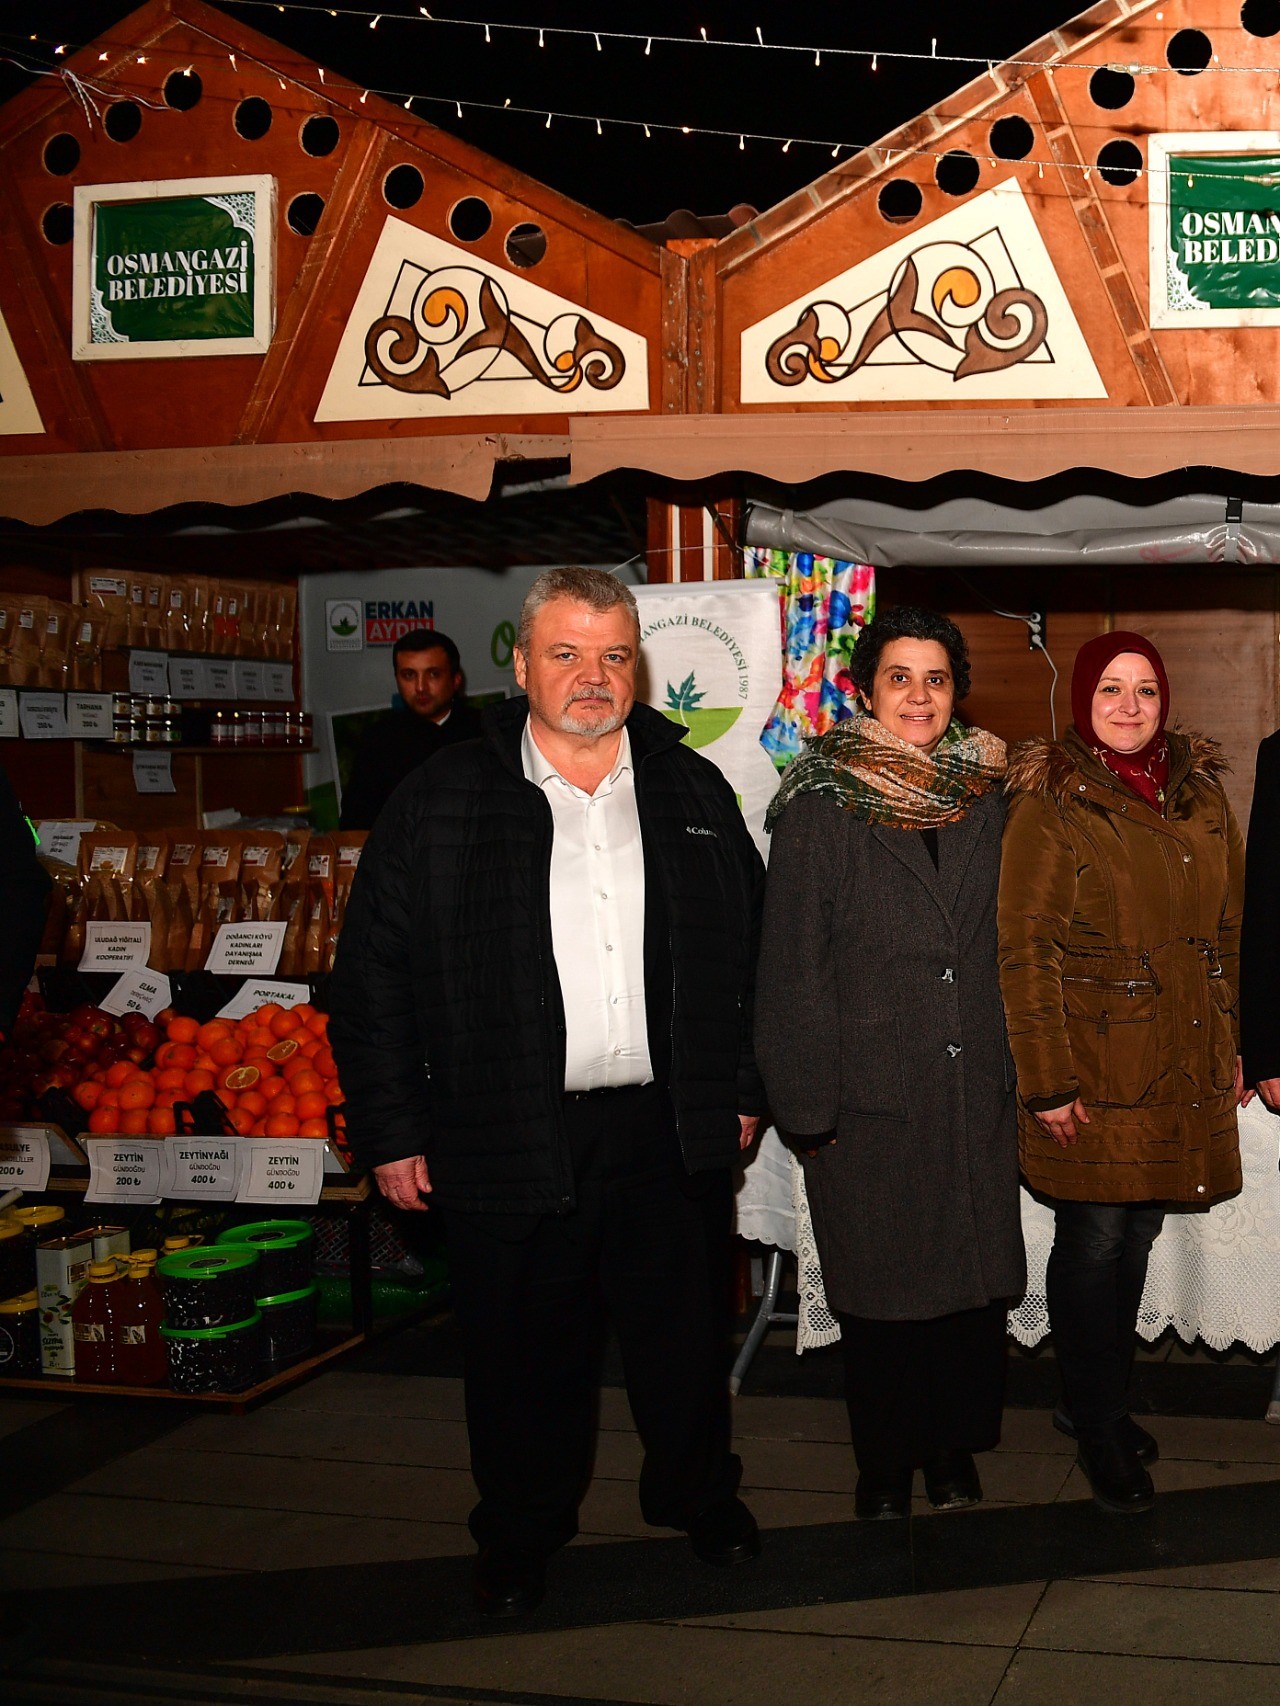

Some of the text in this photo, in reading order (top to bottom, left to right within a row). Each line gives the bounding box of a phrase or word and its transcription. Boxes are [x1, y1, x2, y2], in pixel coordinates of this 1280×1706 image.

[107, 240, 248, 276] OSMANGAZİ
[109, 265, 248, 301] BELEDİYESİ
[365, 600, 433, 618] ERKAN
[640, 613, 749, 700] ANGAZİ BELEDİYESİ 1987
[95, 935, 118, 943] ULUDAĞ
[225, 950, 262, 958] DAYANIŞMA
[139, 982, 157, 994] ELMA
[253, 990, 296, 1000] PORTAKAL
[126, 999, 136, 1008] 50
[113, 1152, 143, 1162] ZEYTİN
[179, 1149, 229, 1160] ZEYTİNYAĞI
[268, 1155, 299, 1165] ZEYTİN
[113, 1165, 145, 1173] GÜNDOĞDU
[266, 1168, 300, 1176] GÜNDOĞDU
[116, 1177, 132, 1185] 200
[191, 1175, 208, 1183] 400
[268, 1181, 286, 1189] 400
